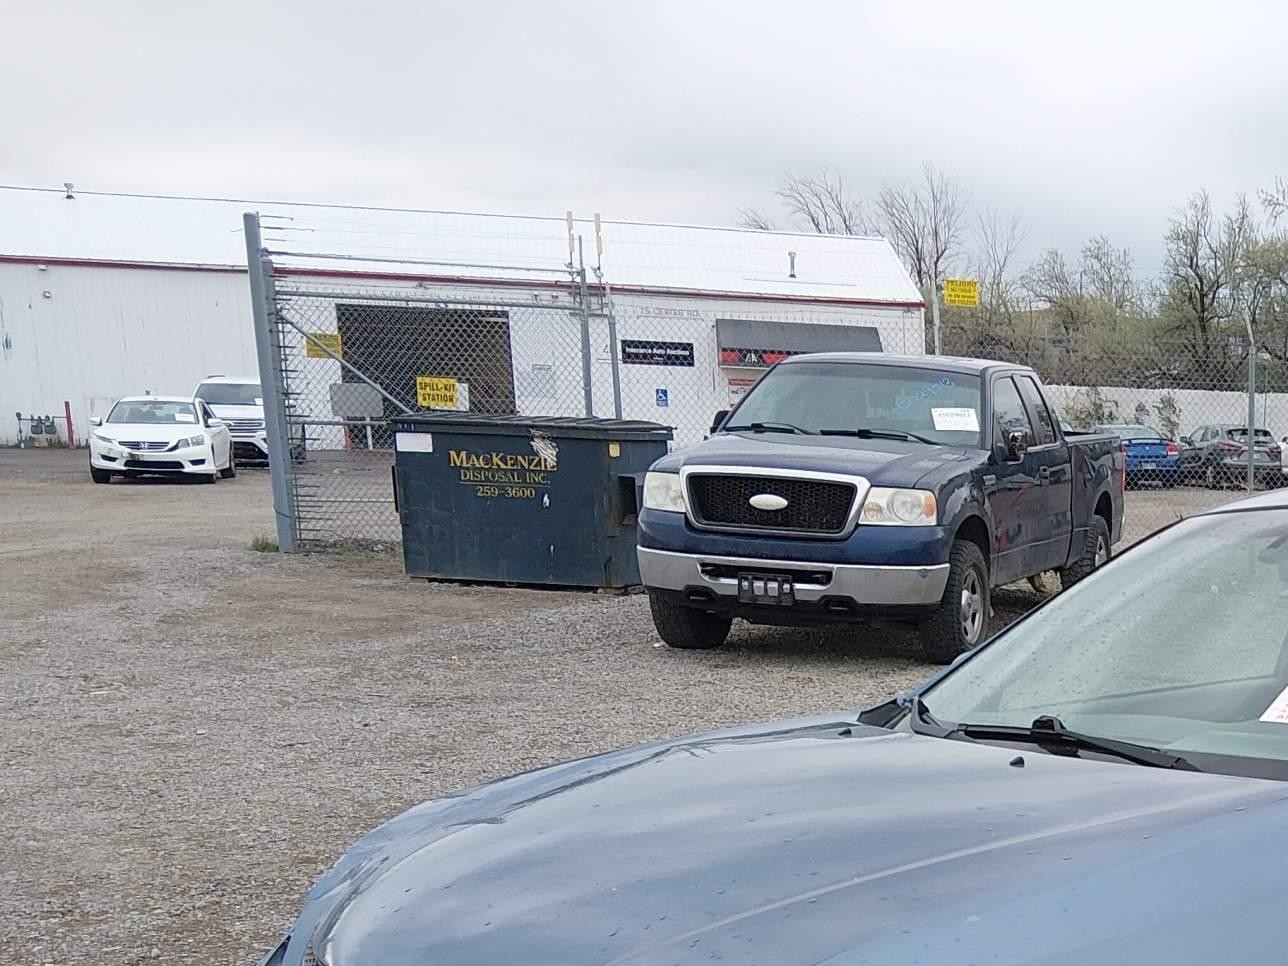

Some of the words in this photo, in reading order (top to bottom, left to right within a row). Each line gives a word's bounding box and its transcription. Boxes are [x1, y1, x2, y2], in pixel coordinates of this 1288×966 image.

[418, 381, 456, 393] SPILL-KIT
[422, 393, 454, 403] STATION
[460, 470, 522, 483] DISPOSAL
[526, 471, 551, 484] INC.
[475, 486, 536, 498] 259-3600
